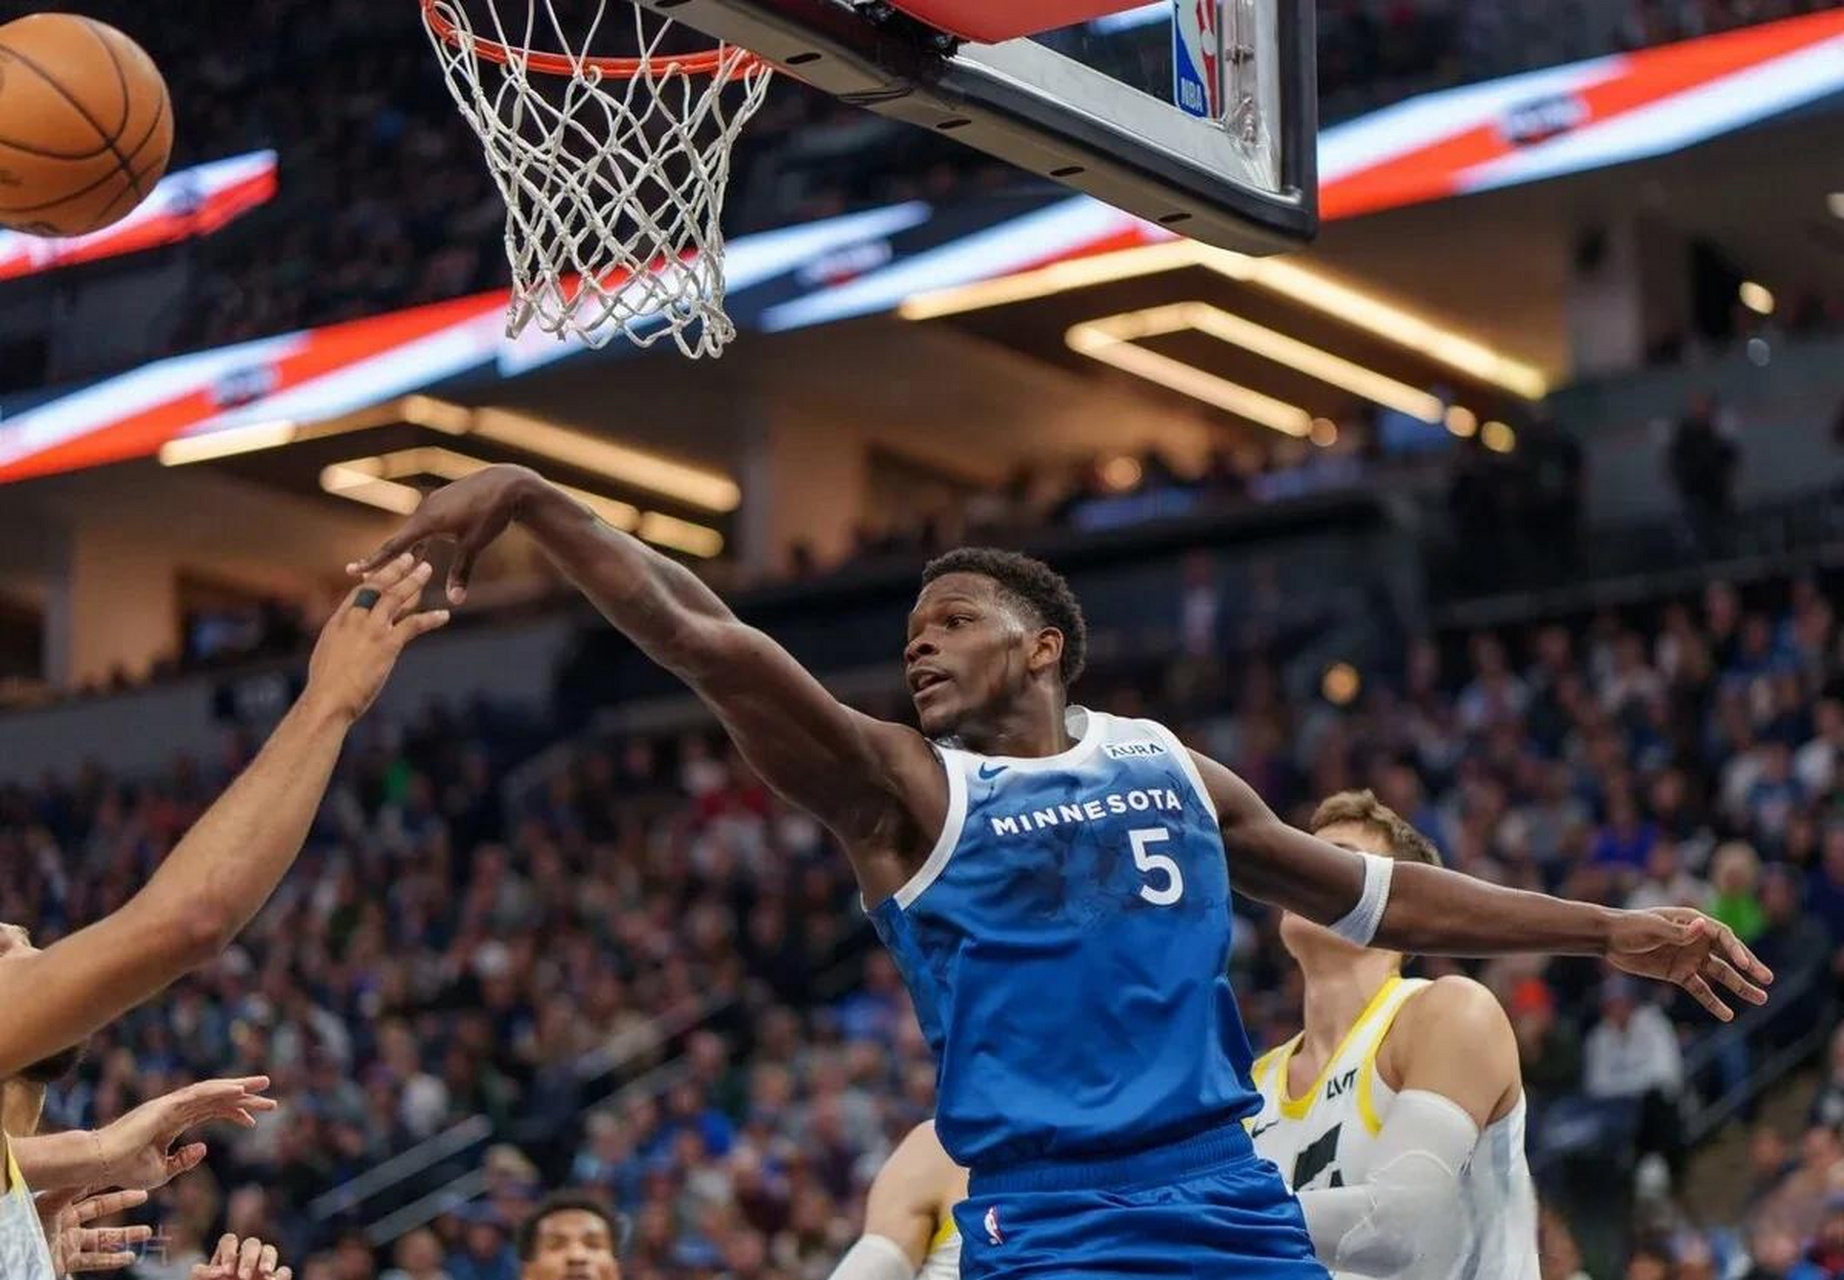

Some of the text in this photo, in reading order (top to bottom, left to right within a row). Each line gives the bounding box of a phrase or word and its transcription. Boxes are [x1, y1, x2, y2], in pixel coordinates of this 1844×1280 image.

[1180, 77, 1204, 113] NBA
[1106, 742, 1164, 758] AURA
[990, 788, 1182, 837] MINNESOTA
[1128, 827, 1184, 906] 5
